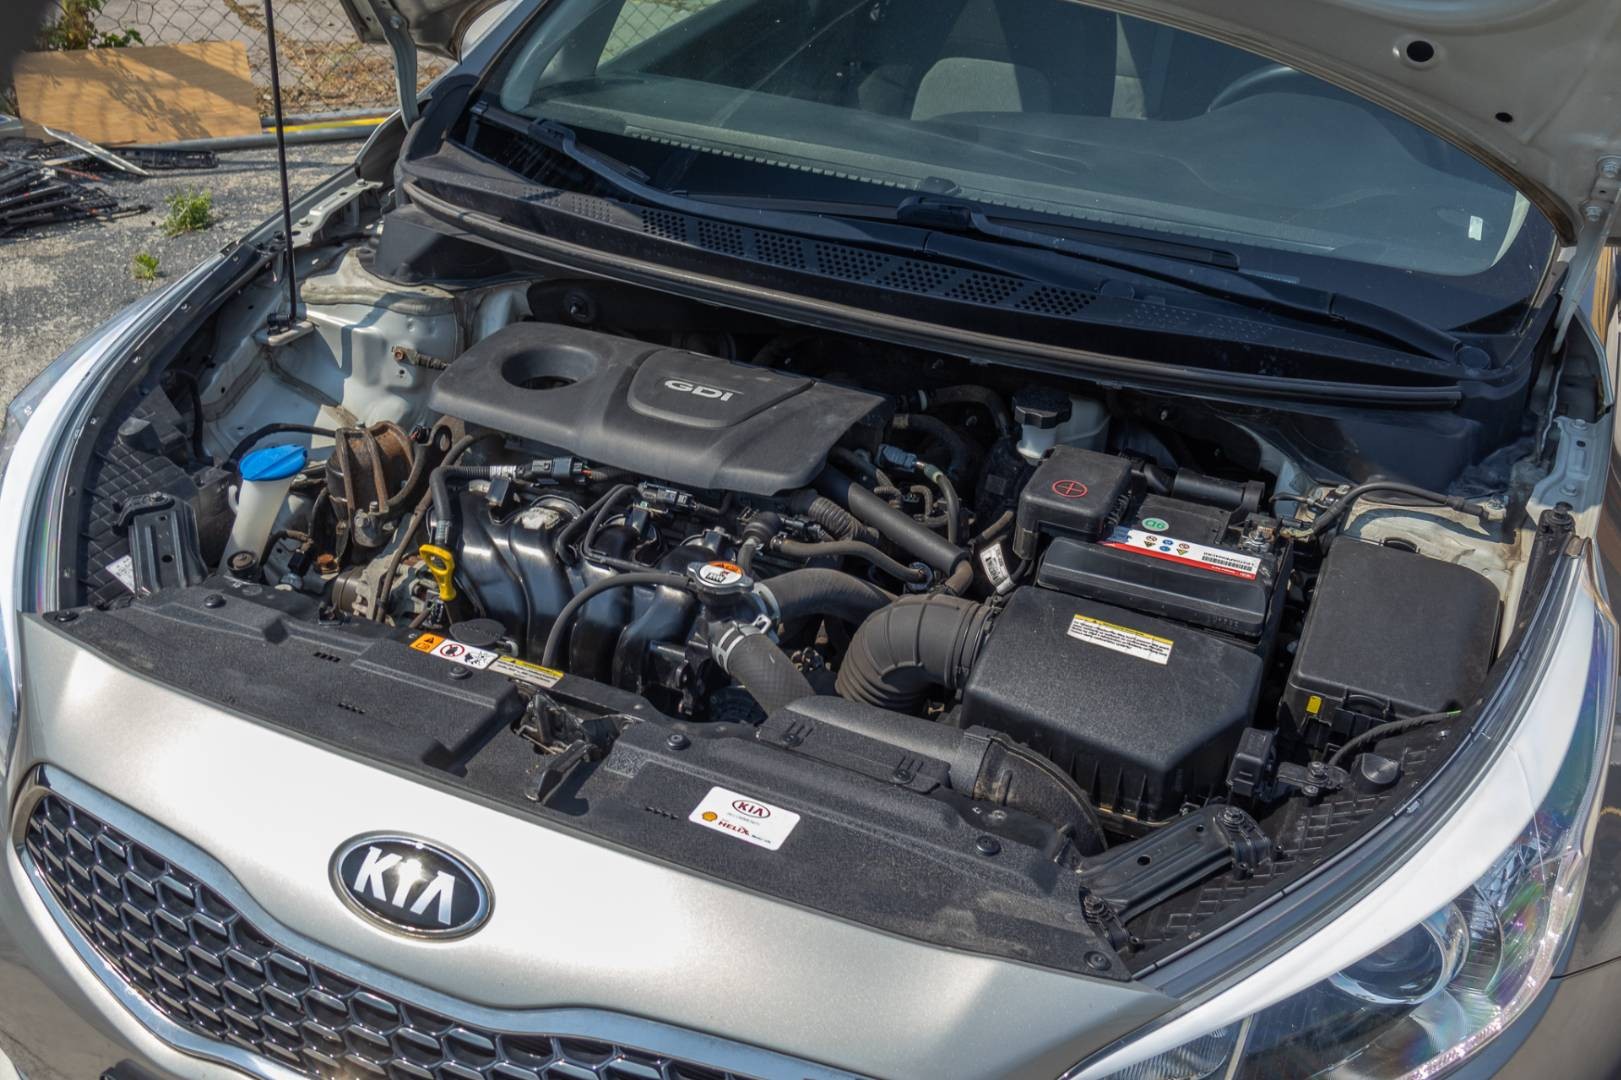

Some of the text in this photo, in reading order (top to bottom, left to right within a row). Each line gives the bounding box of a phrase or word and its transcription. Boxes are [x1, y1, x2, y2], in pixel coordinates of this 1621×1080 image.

[664, 380, 734, 402] GDI
[738, 801, 764, 817] KIA
[718, 820, 750, 836] HELIX
[353, 845, 456, 926] KIA
